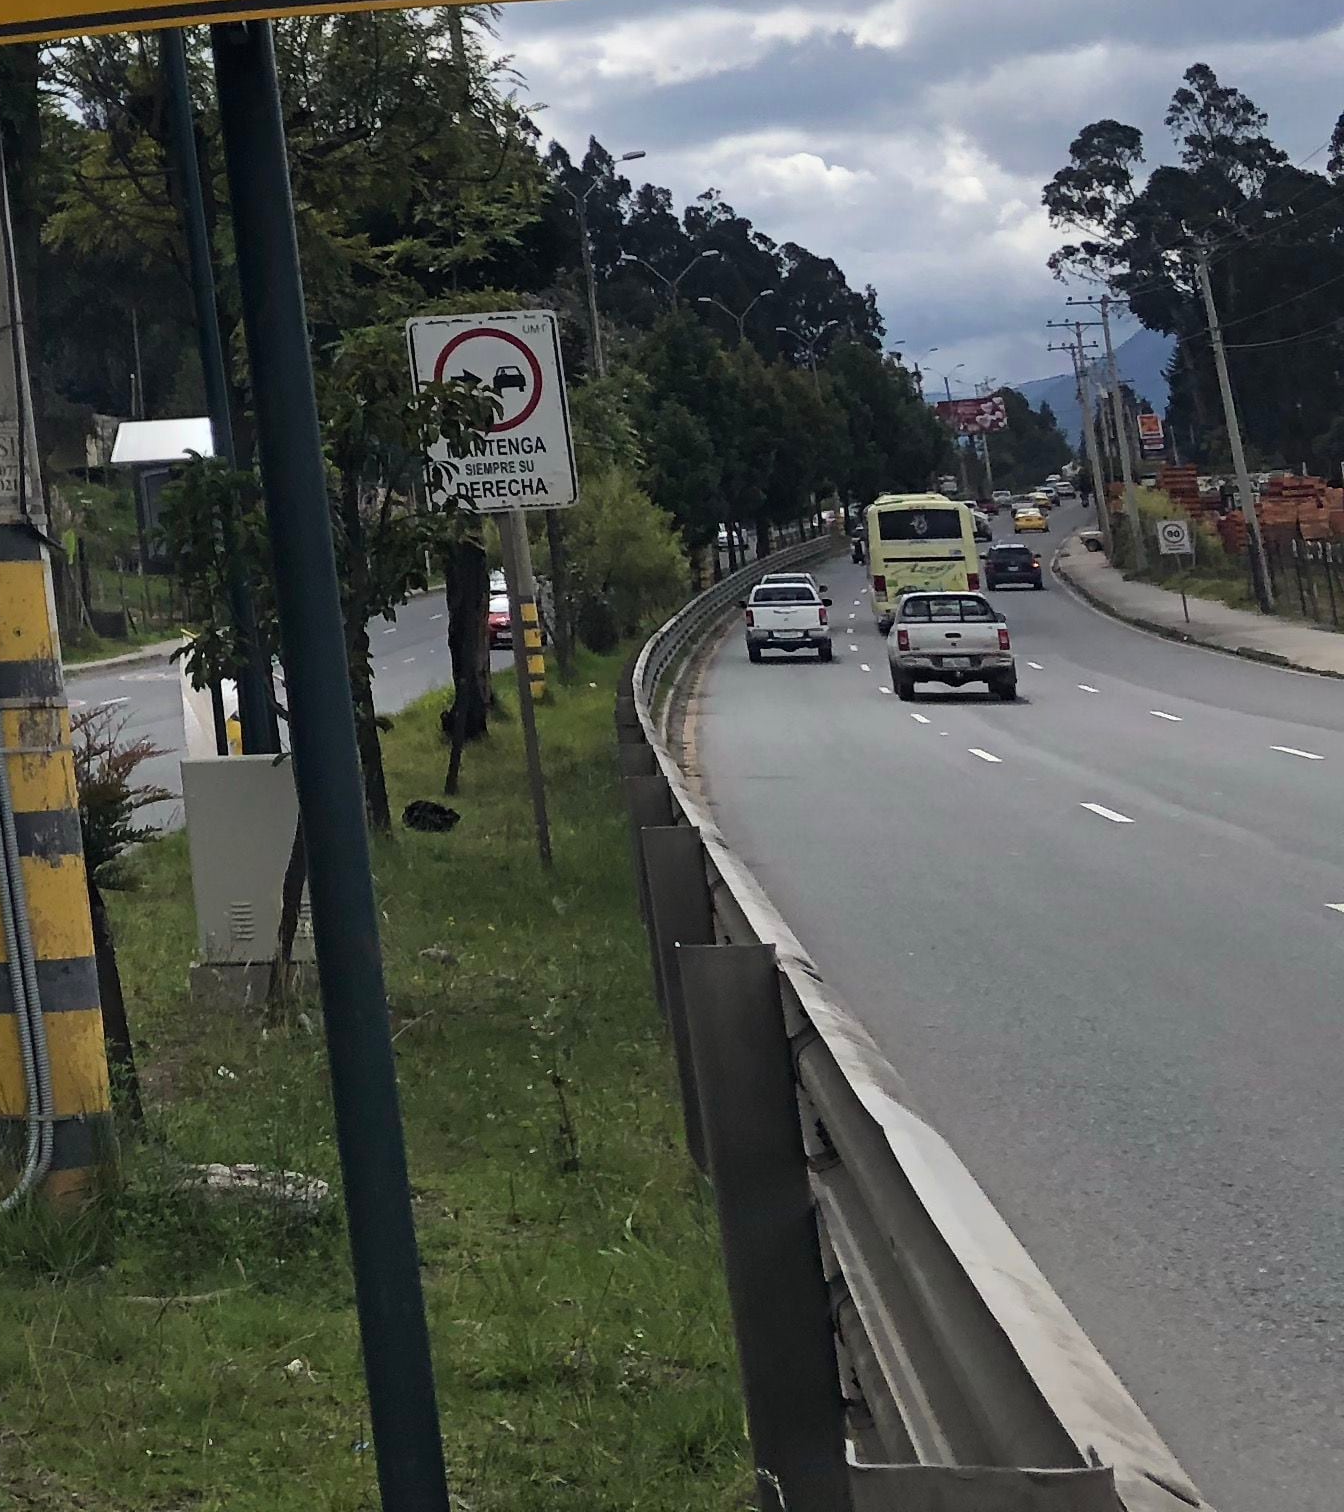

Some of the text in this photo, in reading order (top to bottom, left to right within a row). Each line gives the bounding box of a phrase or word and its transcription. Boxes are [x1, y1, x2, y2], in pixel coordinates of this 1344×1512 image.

[465, 459, 535, 476] SIEMPRE SU
[456, 477, 549, 499] DERECHA
